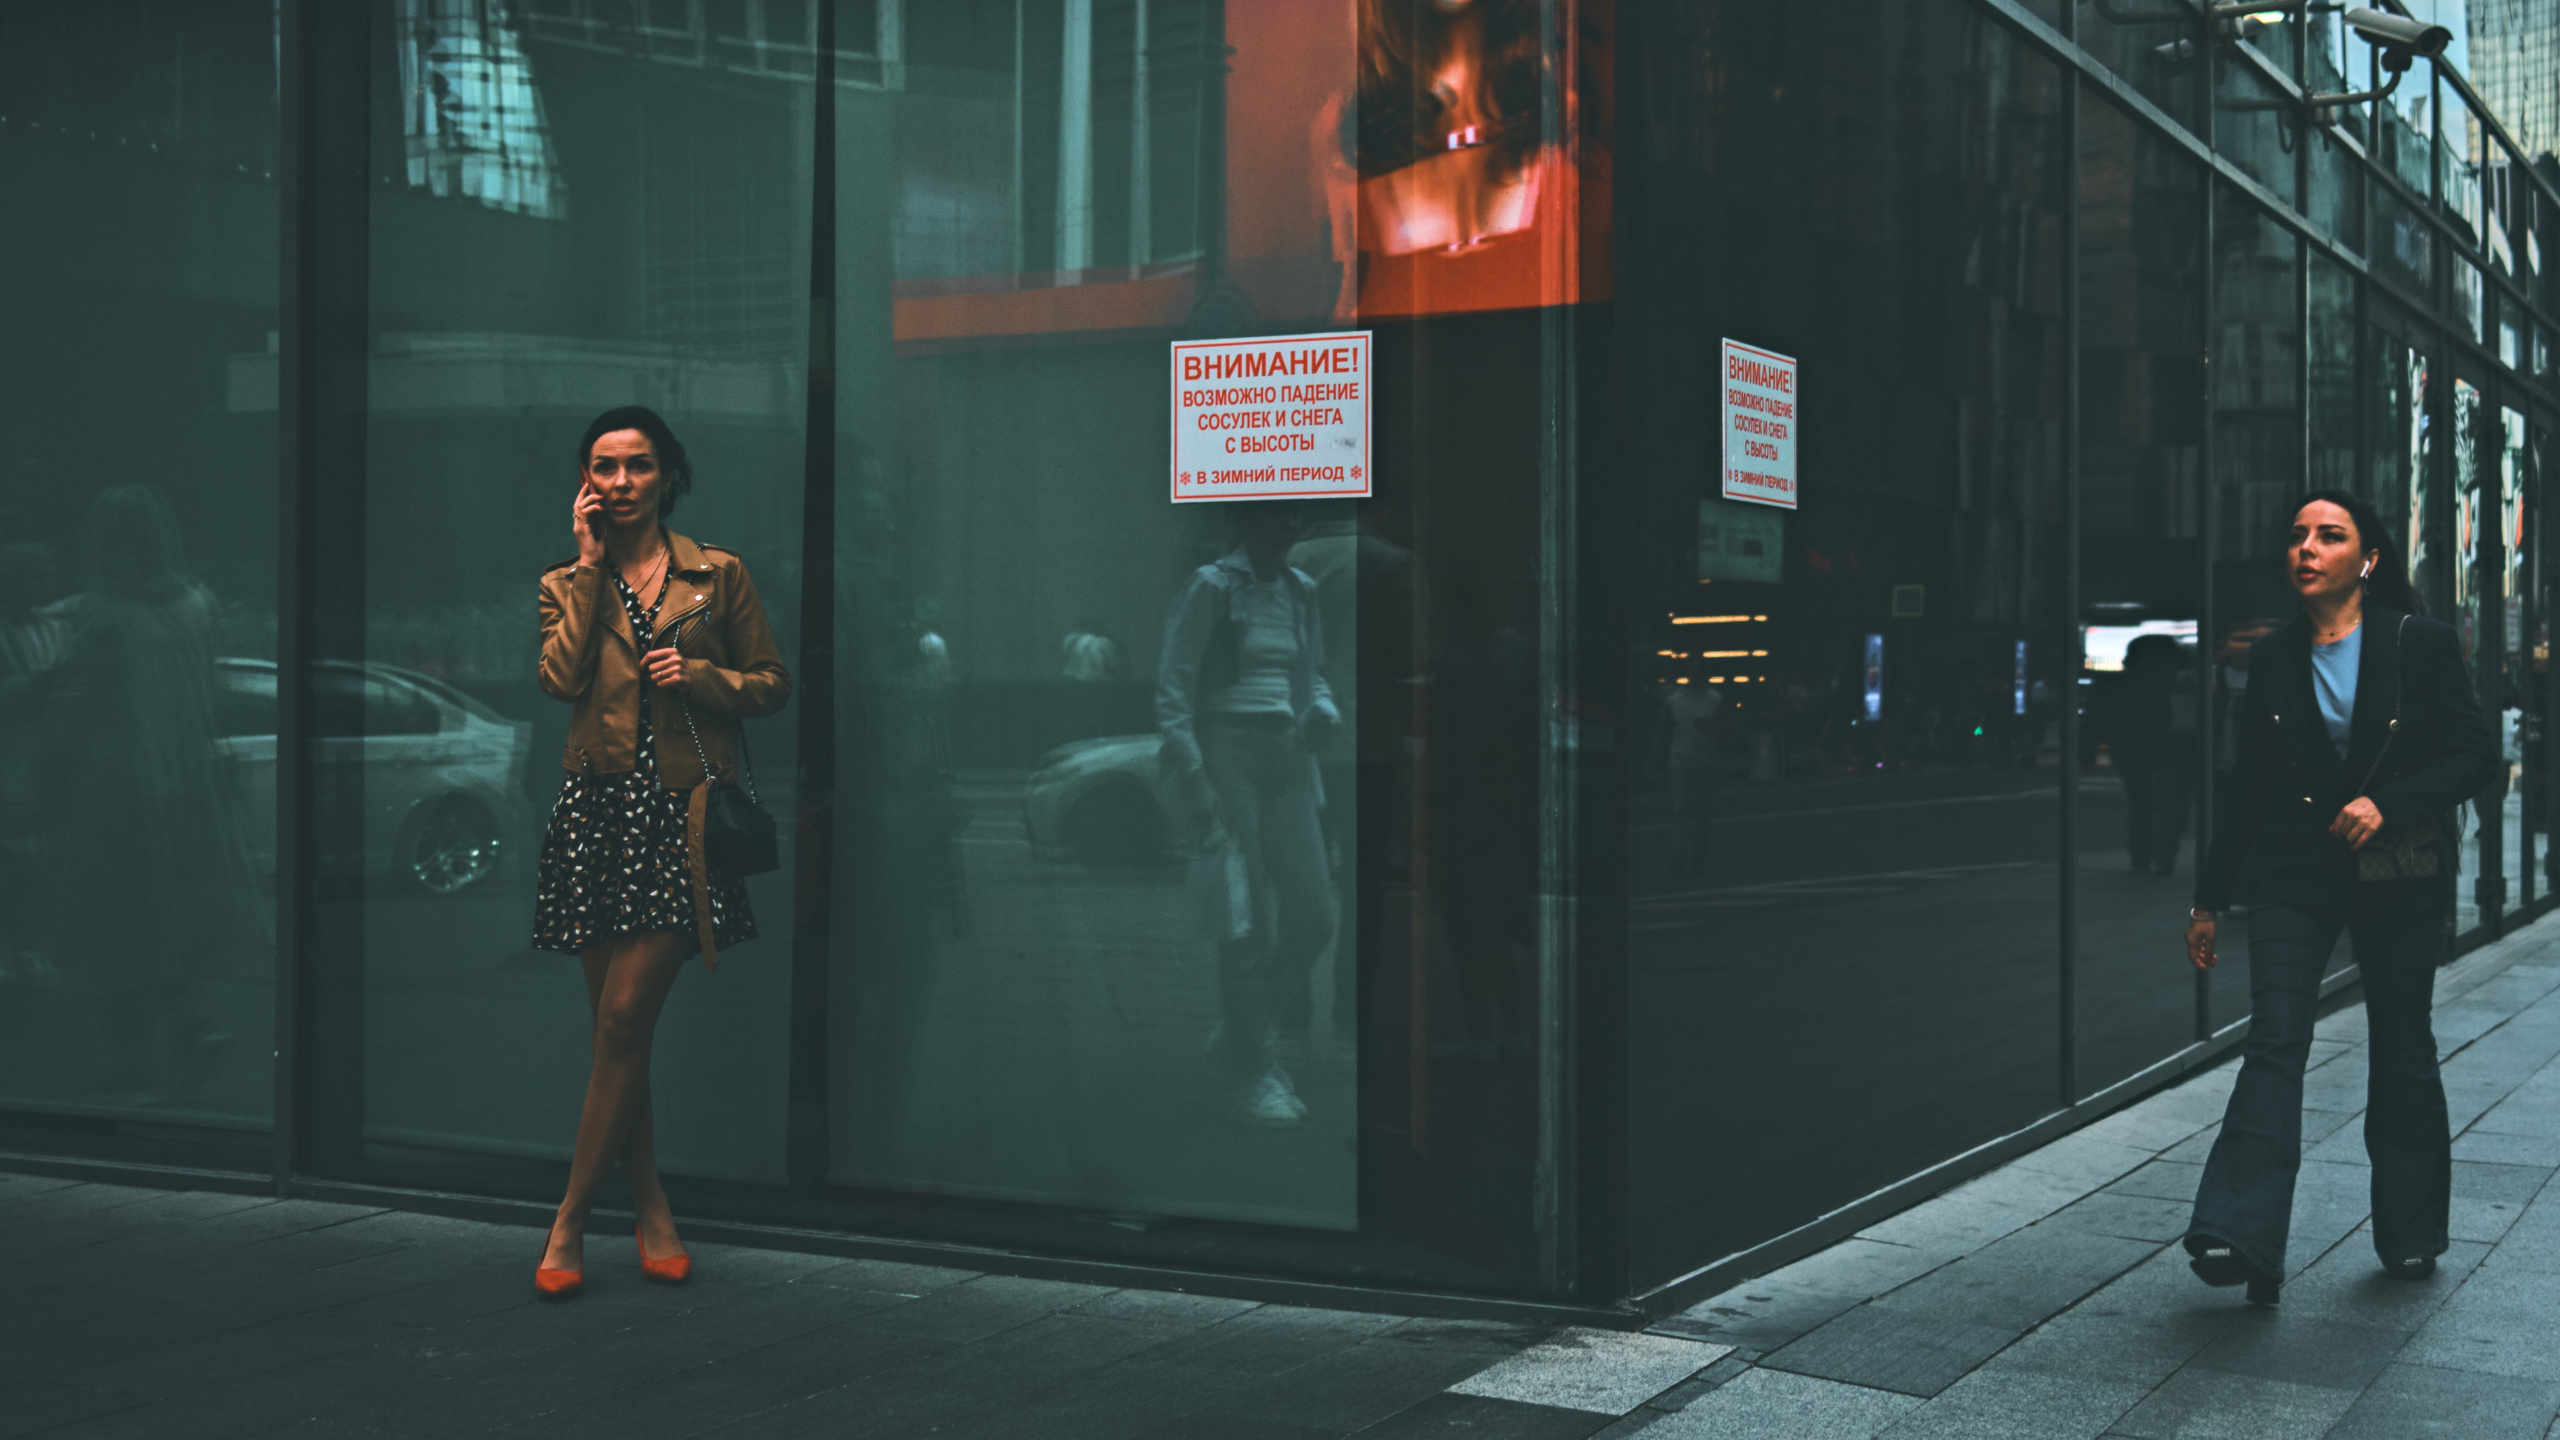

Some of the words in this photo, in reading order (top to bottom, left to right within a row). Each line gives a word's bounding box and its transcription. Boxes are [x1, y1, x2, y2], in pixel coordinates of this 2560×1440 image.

[1184, 348, 1358, 380] ВНИМАНИЕ!
[1729, 355, 1792, 394] ВНИМАНИЕ!
[1183, 386, 1276, 407] ВОЗМОЖНО
[1281, 383, 1359, 404] ПАДЕНИЕ
[1729, 389, 1764, 412] ВОЗМОЖНО
[1765, 398, 1792, 419] ПАДЕНИЕ
[1198, 411, 1270, 430] СОСУЛЕК
[1276, 411, 1286, 427] И
[1291, 408, 1343, 426] СНЕГА
[1735, 414, 1762, 434] СОСУЛЕК
[1763, 420, 1768, 436] И
[1768, 422, 1787, 440] СНЕГА
[1225, 437, 1236, 453] С
[1241, 434, 1314, 453] ВЫСОТЫ
[1745, 440, 1750, 455] С
[1751, 441, 1778, 460] ВЫСОТЫ
[1197, 471, 1207, 484] В
[1212, 465, 1275, 483] ЗИМНИЙ
[1280, 466, 1344, 481] ПЕРИОД
[1734, 469, 1739, 482] В
[1740, 471, 1764, 486] ЗИМНИЙ
[1765, 475, 1788, 492] ПЕРИОД
